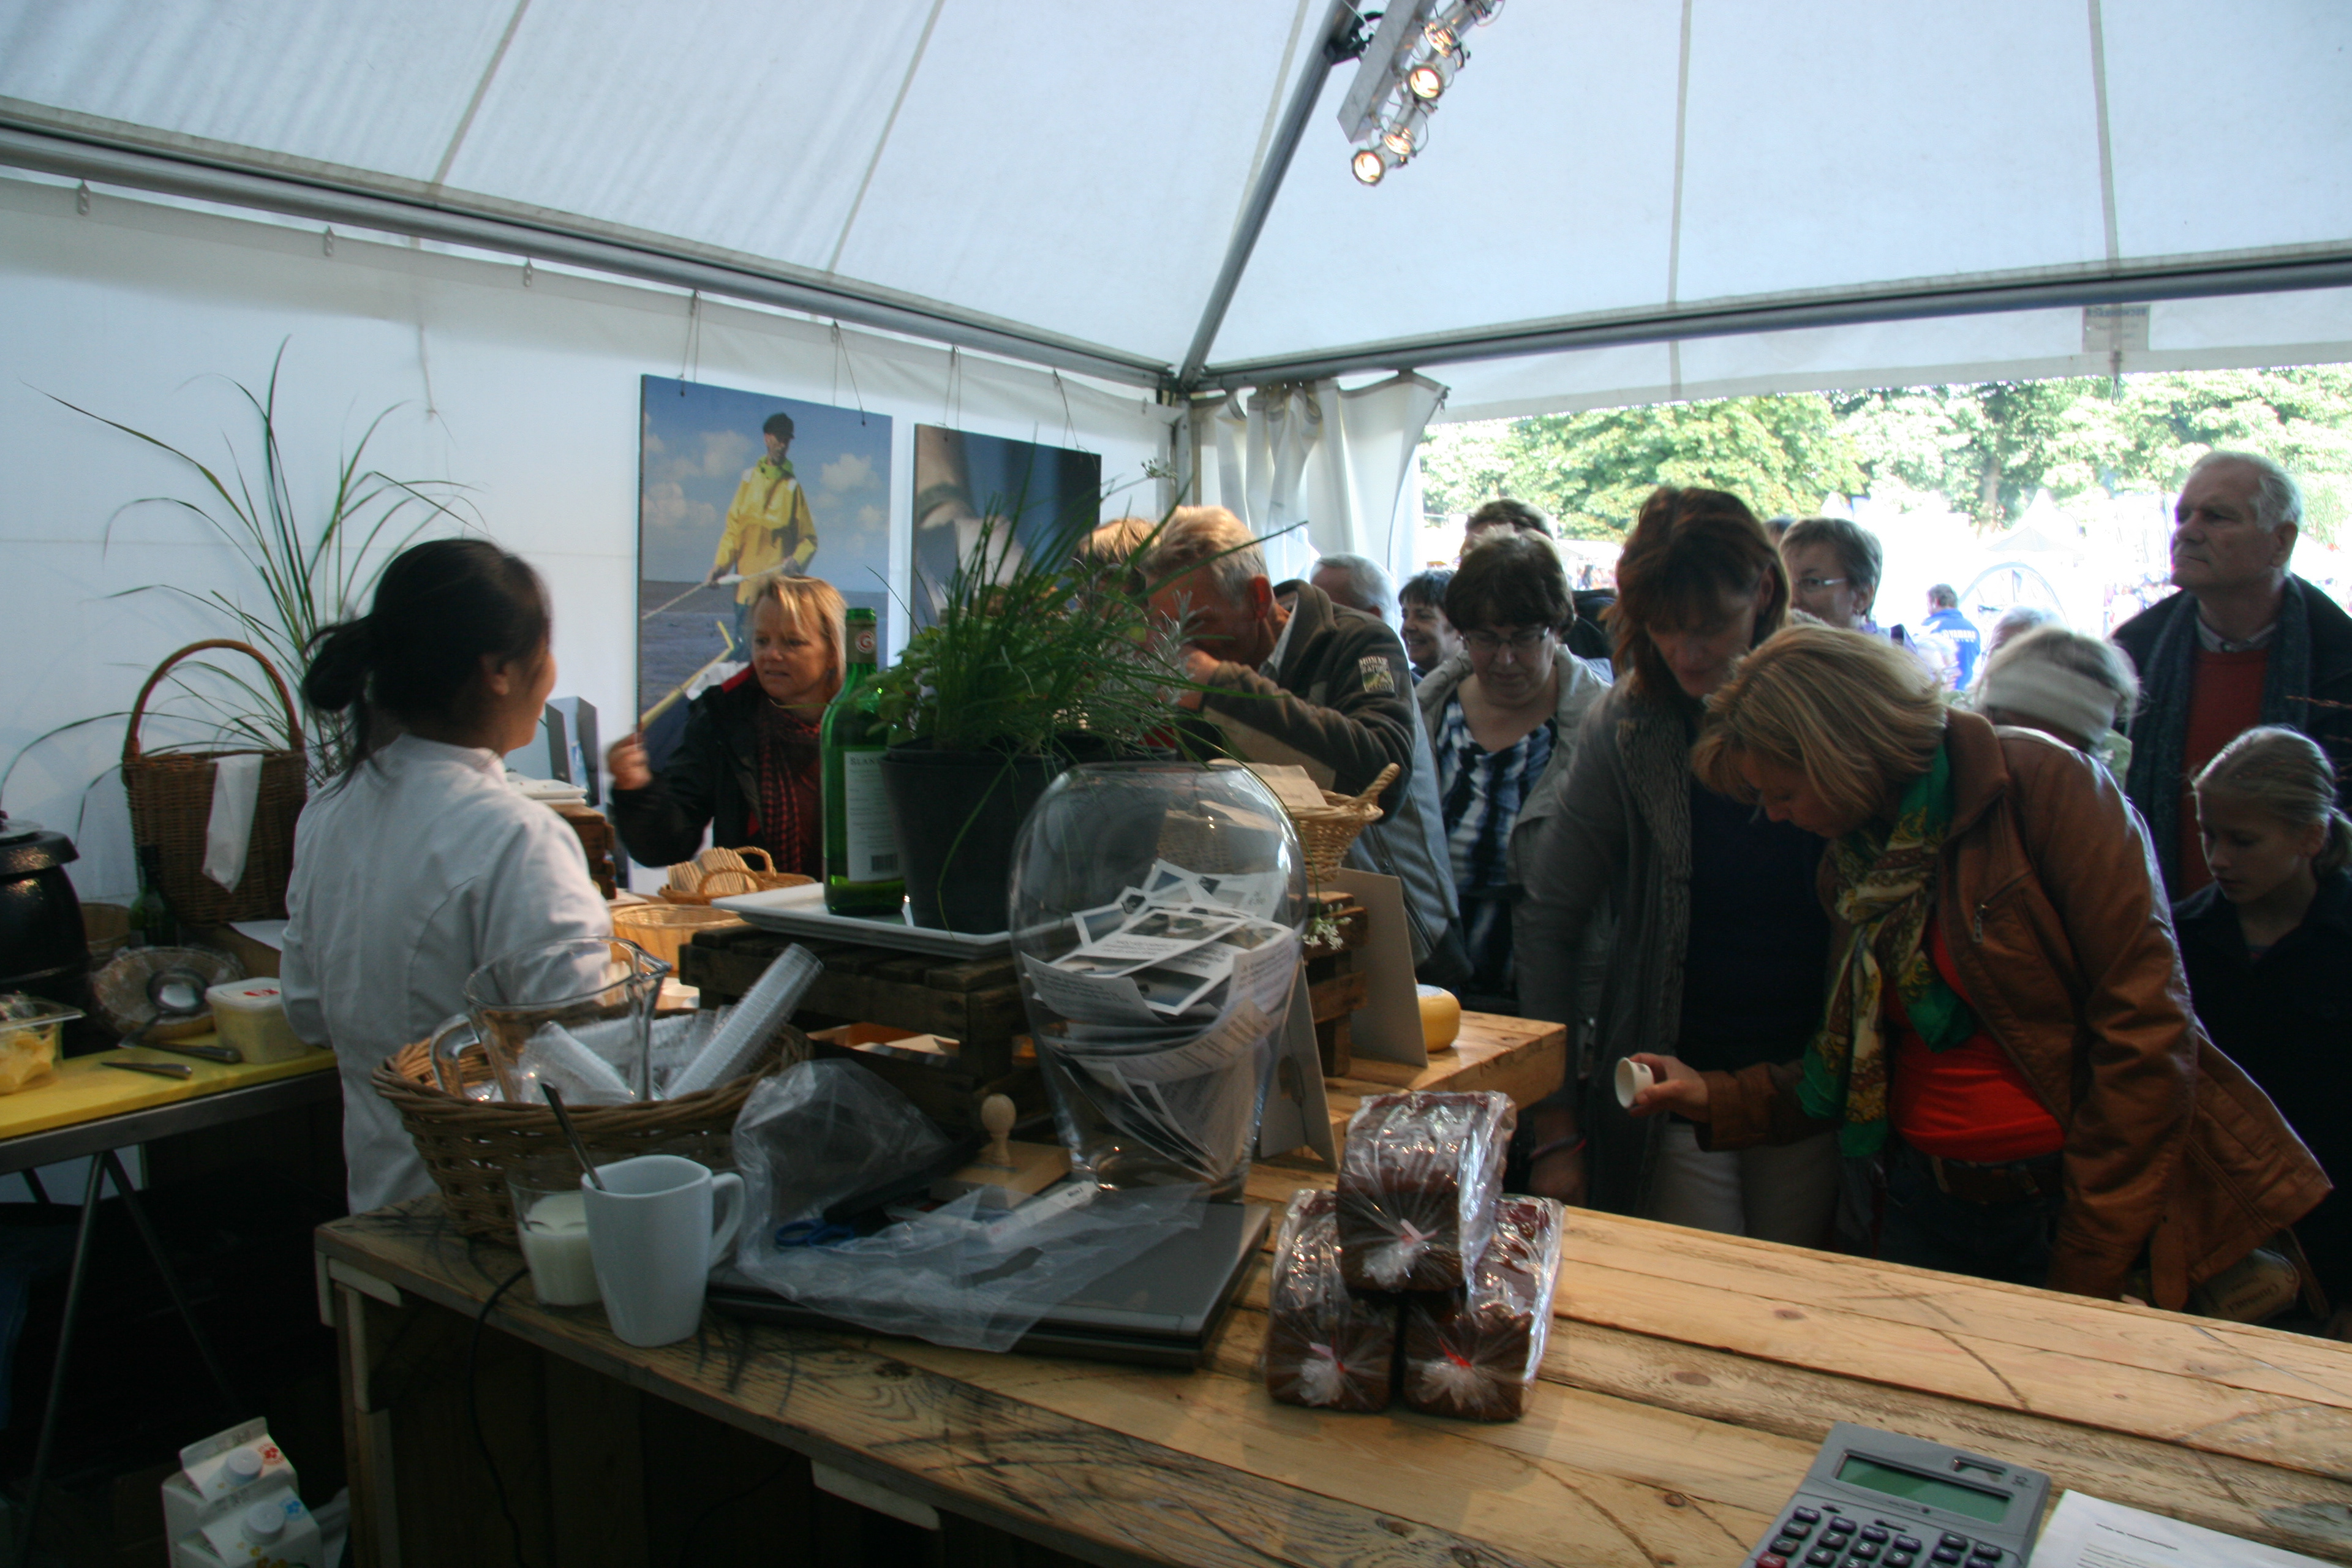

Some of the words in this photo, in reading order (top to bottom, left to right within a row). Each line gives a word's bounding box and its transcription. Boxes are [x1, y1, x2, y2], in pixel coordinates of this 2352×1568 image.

[1827, 1532, 1839, 1541] 7
[1859, 1542, 1871, 1551] 8
[1815, 1550, 1827, 1559] 4
[1894, 1552, 1904, 1561] 9
[1848, 1558, 1860, 1567] 5
